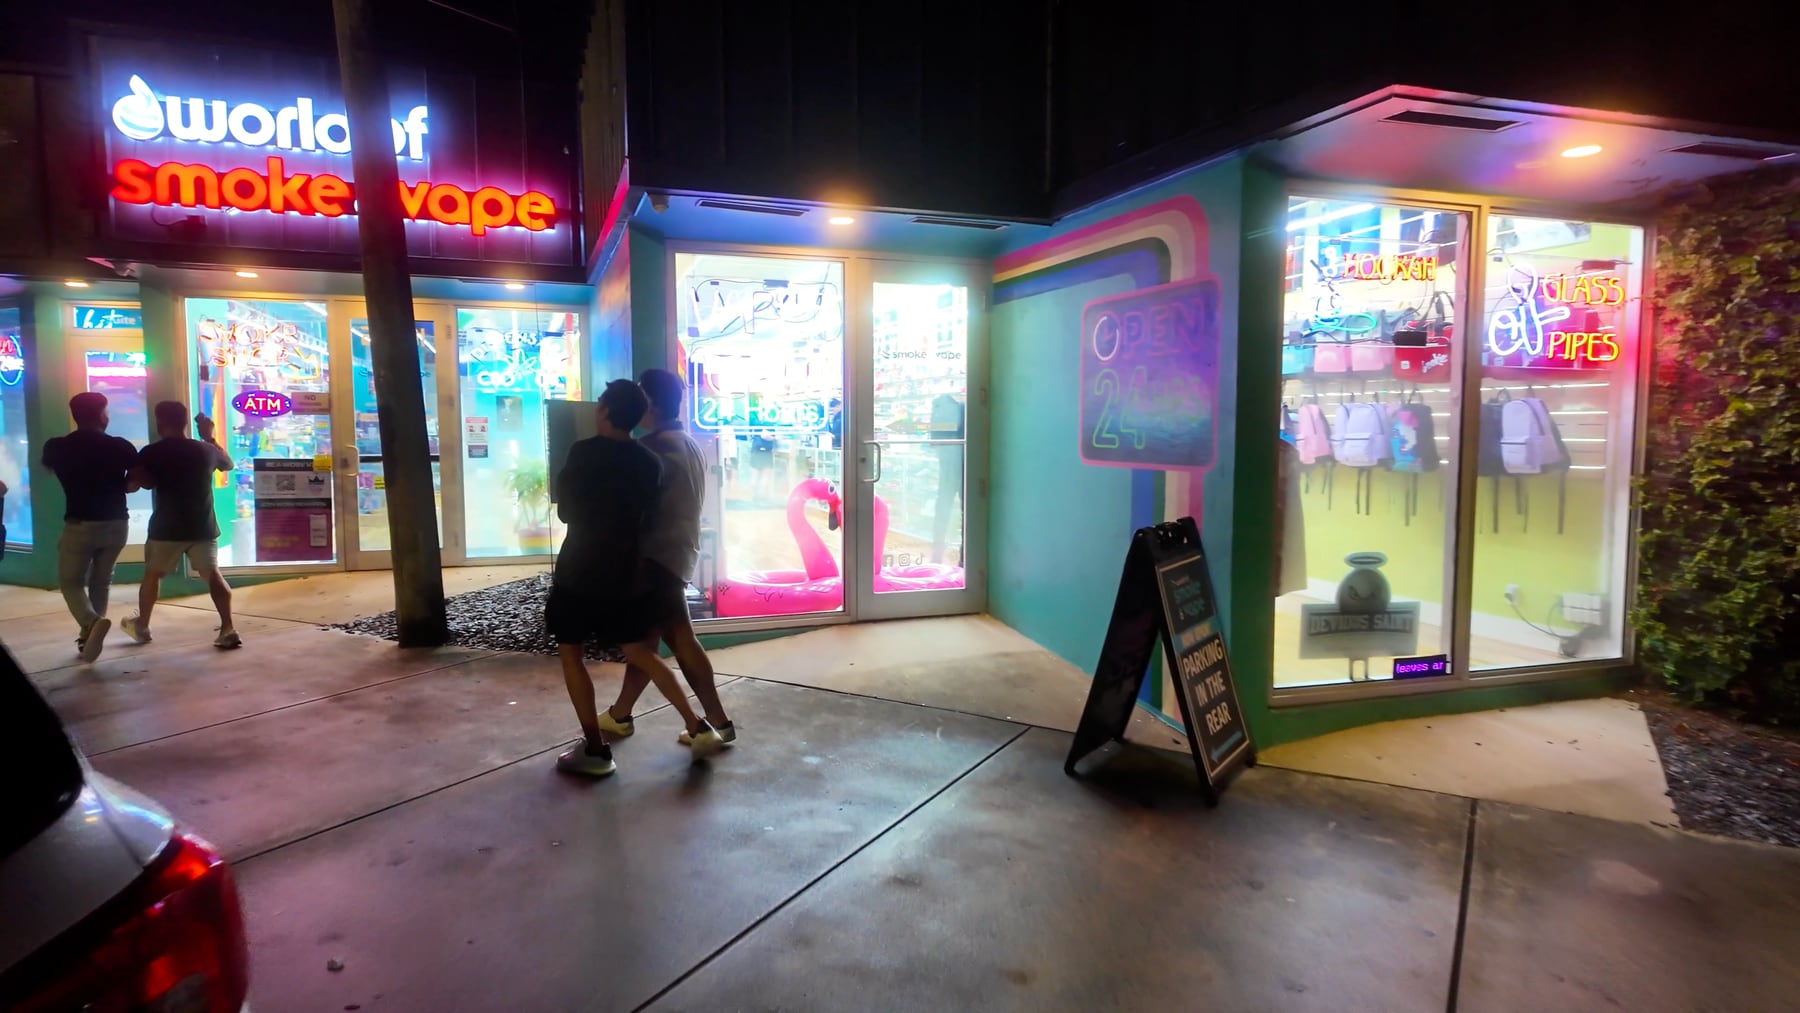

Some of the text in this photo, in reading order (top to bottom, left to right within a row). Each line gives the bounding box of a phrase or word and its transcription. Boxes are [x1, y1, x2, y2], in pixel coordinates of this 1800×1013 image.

[111, 155, 556, 236] smoke vape
[1343, 253, 1437, 281] HOOKAH
[1541, 273, 1626, 306] GLASS
[1092, 297, 1205, 365] OPEN
[1547, 331, 1620, 362] PIPES
[892, 349, 928, 359] smoke
[244, 397, 281, 411] ATM
[1092, 365, 1148, 449] 24
[1182, 639, 1224, 680] PARKING
[1194, 670, 1227, 707] IN THE
[1205, 701, 1232, 736] REAR
